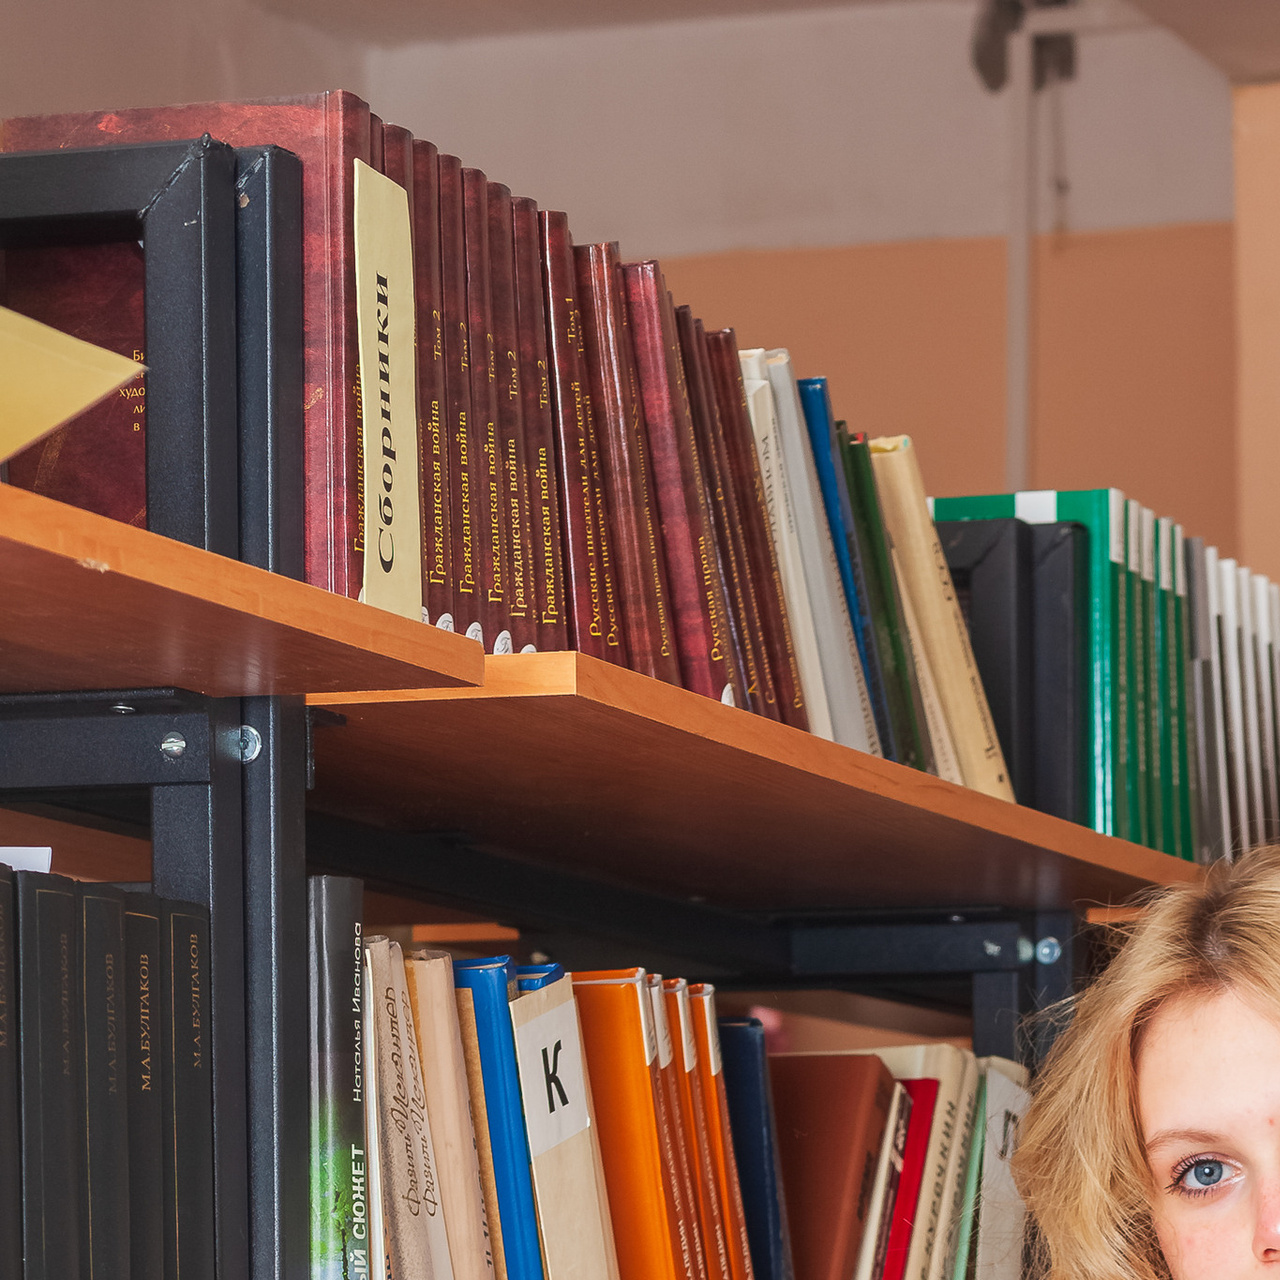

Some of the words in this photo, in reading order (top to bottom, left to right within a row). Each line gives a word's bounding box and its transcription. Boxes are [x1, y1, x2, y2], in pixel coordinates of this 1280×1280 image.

[433, 310, 442, 326] 2
[460, 321, 469, 334] 2
[486, 332, 495, 344] 2
[567, 309, 577, 347] Том
[434, 331, 443, 361] Том
[461, 342, 470, 372] Том
[488, 353, 497, 383] Том
[507, 349, 518, 361] 2
[537, 358, 547, 371] 2
[509, 371, 519, 401] Том
[540, 379, 549, 409] Том
[573, 380, 586, 429] детей
[376, 271, 397, 574] Сборники
[427, 400, 440, 455] война
[455, 411, 468, 466] война
[484, 421, 497, 476] война
[504, 438, 517, 493] война
[535, 446, 548, 500] война
[577, 436, 589, 471] для
[430, 461, 445, 586] Гражданская
[459, 471, 474, 595] Гражданская
[487, 480, 503, 604] Гражданская
[579, 481, 595, 567] писатели
[509, 495, 527, 618] Гражданская
[542, 503, 558, 626] Гражданская
[651, 558, 662, 598] проза
[698, 536, 712, 586] проза
[589, 570, 603, 639] Русские
[606, 581, 620, 649] Русские
[656, 602, 671, 658] Русская
[706, 591, 724, 662] Русская
[351, 922, 363, 1013] Иванова
[139, 954, 152, 1091] М.А.БУЛГАКОВ
[352, 1020, 363, 1103] Наталья
[540, 1039, 570, 1115] К
[351, 1143, 366, 1240] СЮЖЕТ
